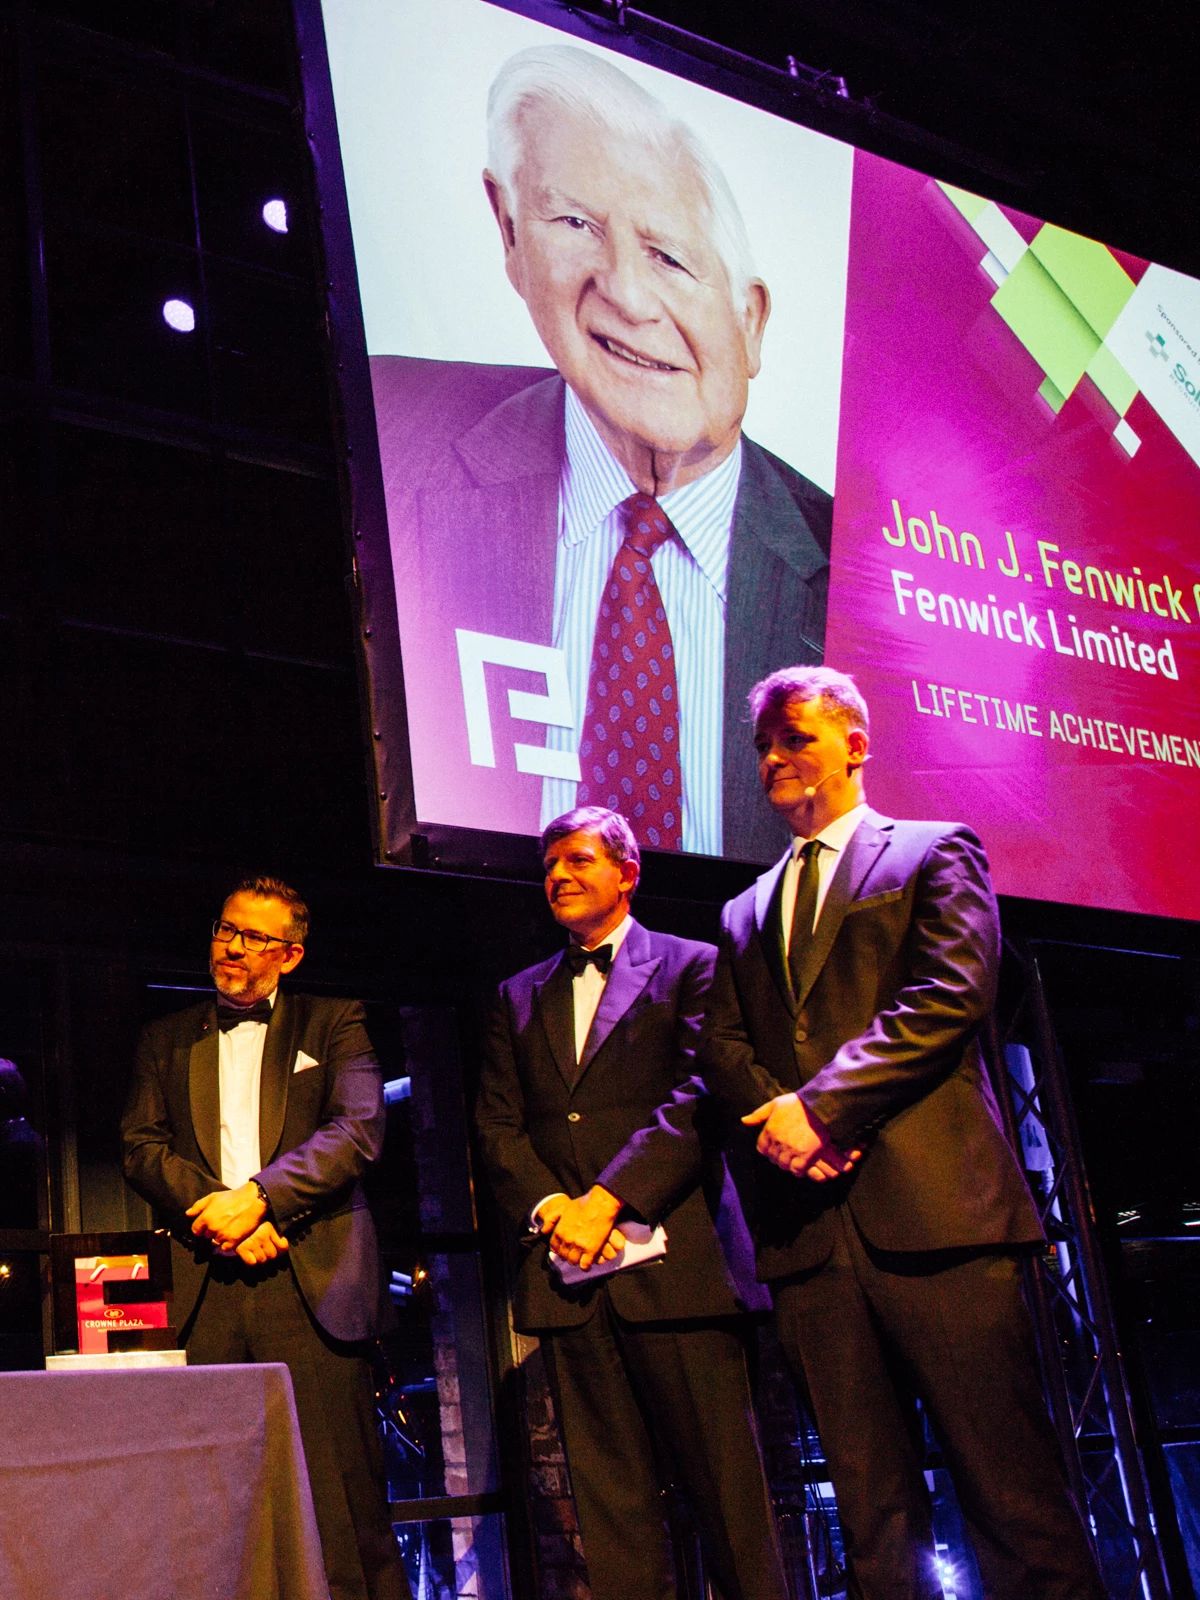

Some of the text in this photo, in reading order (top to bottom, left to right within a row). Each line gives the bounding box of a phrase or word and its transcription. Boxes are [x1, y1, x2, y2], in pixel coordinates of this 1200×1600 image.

[882, 499, 985, 569] John
[997, 532, 1033, 582] J.
[1037, 540, 1191, 624] Fenwick
[891, 569, 1179, 681] Fenwick Limited
[912, 680, 1200, 768] LIFETIME ACHIEVEMEN
[85, 1319, 144, 1329] CROWNE PLAZA
